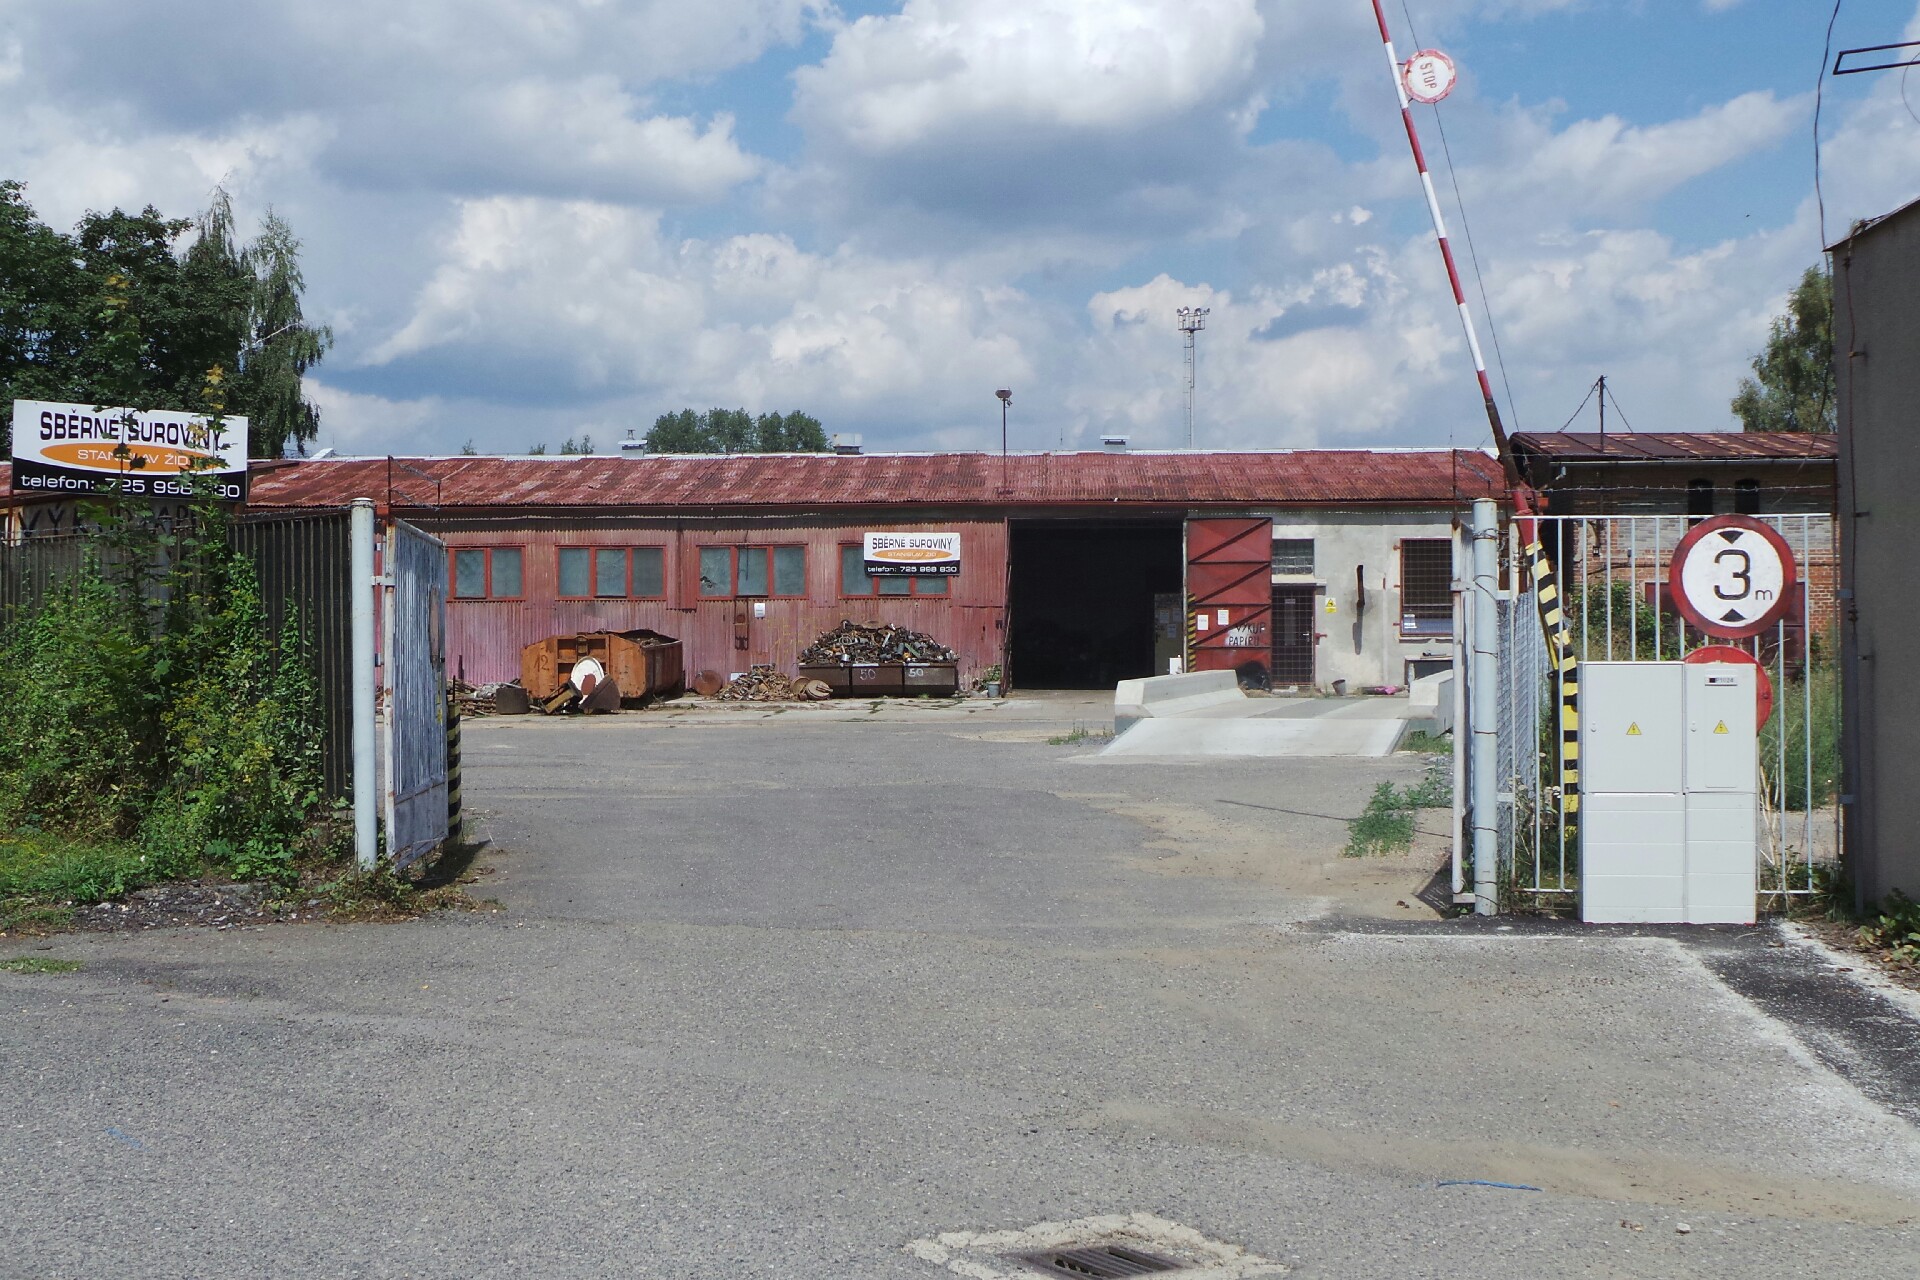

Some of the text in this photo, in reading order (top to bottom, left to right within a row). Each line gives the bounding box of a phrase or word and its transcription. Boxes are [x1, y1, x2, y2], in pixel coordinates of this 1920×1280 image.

[1420, 62, 1437, 89] STOP
[40, 408, 120, 441] SBĚRNÉ
[20, 475, 95, 490] telefon:
[201, 483, 240, 498] 30
[872, 536, 953, 550] SBĚRNÉ SUROVINY
[1714, 549, 1773, 601] 3 m
[534, 654, 550, 672] 12
[908, 667, 924, 678] 50
[859, 668, 876, 680] 50
